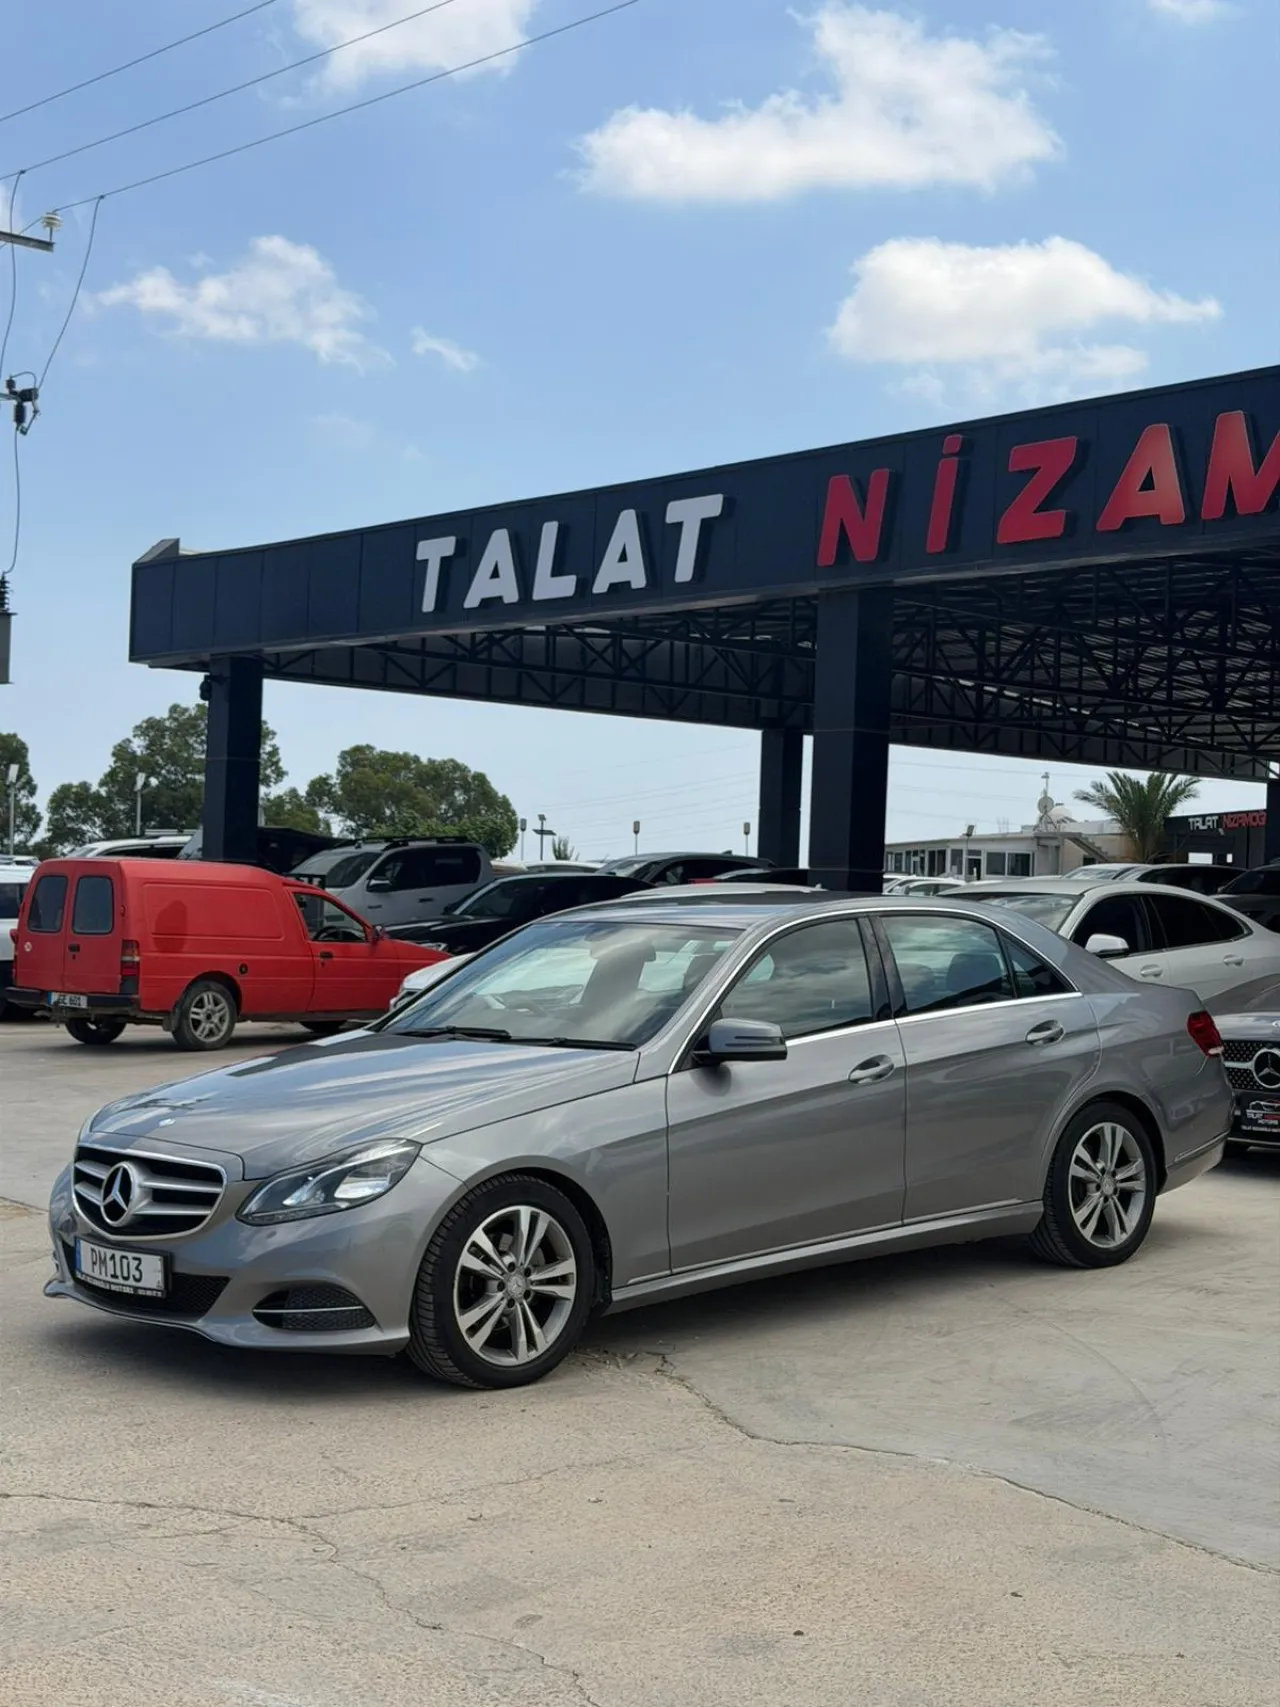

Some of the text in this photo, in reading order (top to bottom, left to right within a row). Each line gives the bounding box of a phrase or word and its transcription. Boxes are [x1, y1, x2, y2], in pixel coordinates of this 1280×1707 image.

[416, 410, 1280, 613] TALAT NİZAM
[1188, 816, 1219, 830] TALAT
[91, 1247, 143, 1283] PM103
